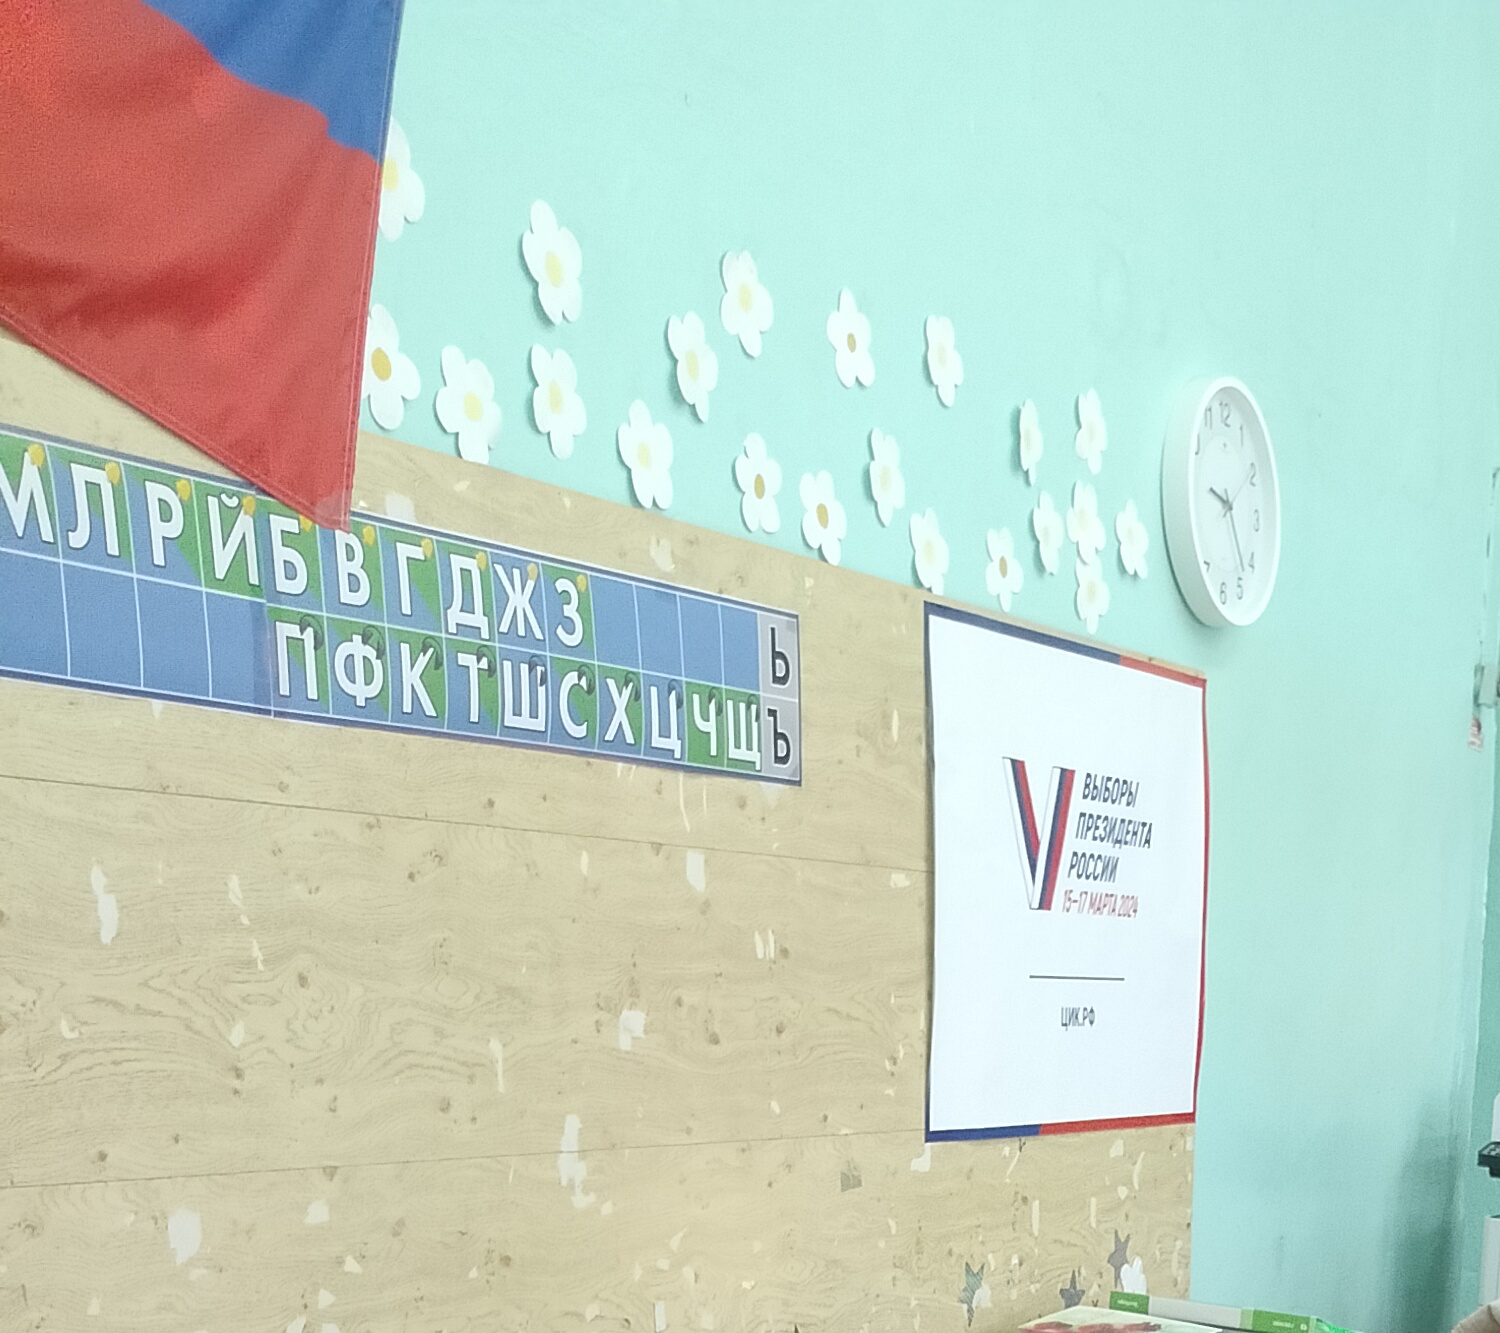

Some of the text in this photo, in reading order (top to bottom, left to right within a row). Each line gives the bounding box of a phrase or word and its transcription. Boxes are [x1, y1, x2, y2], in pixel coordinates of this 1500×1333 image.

[1219, 402, 1231, 428] 12
[1250, 462, 1257, 488] 2
[1253, 508, 1260, 533] 3
[67, 462, 120, 556] Л
[144, 480, 185, 567] Р
[207, 492, 260, 586] Й
[269, 513, 309, 596] Б
[335, 528, 372, 607] В
[396, 541, 426, 617] Г
[446, 553, 490, 640] Д
[493, 562, 544, 641] Ж
[554, 577, 584, 647] З
[769, 626, 791, 686] Ь
[1248, 551, 1255, 574] 4
[1219, 581, 1228, 606] 6
[1236, 576, 1244, 601] 5
[275, 622, 791, 771] П Ф К Т Ш С Х Ц Ч Щ Ъ
[1082, 772, 1140, 808] ВЫБОРЫ
[1075, 811, 1152, 850] ПРЕЗИДЕНТА
[1067, 850, 1119, 883] РОССИИ
[1087, 891, 1118, 916] МАРТА
[1117, 894, 1139, 918] 2024
[1061, 1006, 1096, 1031] ЦИК.РФ
